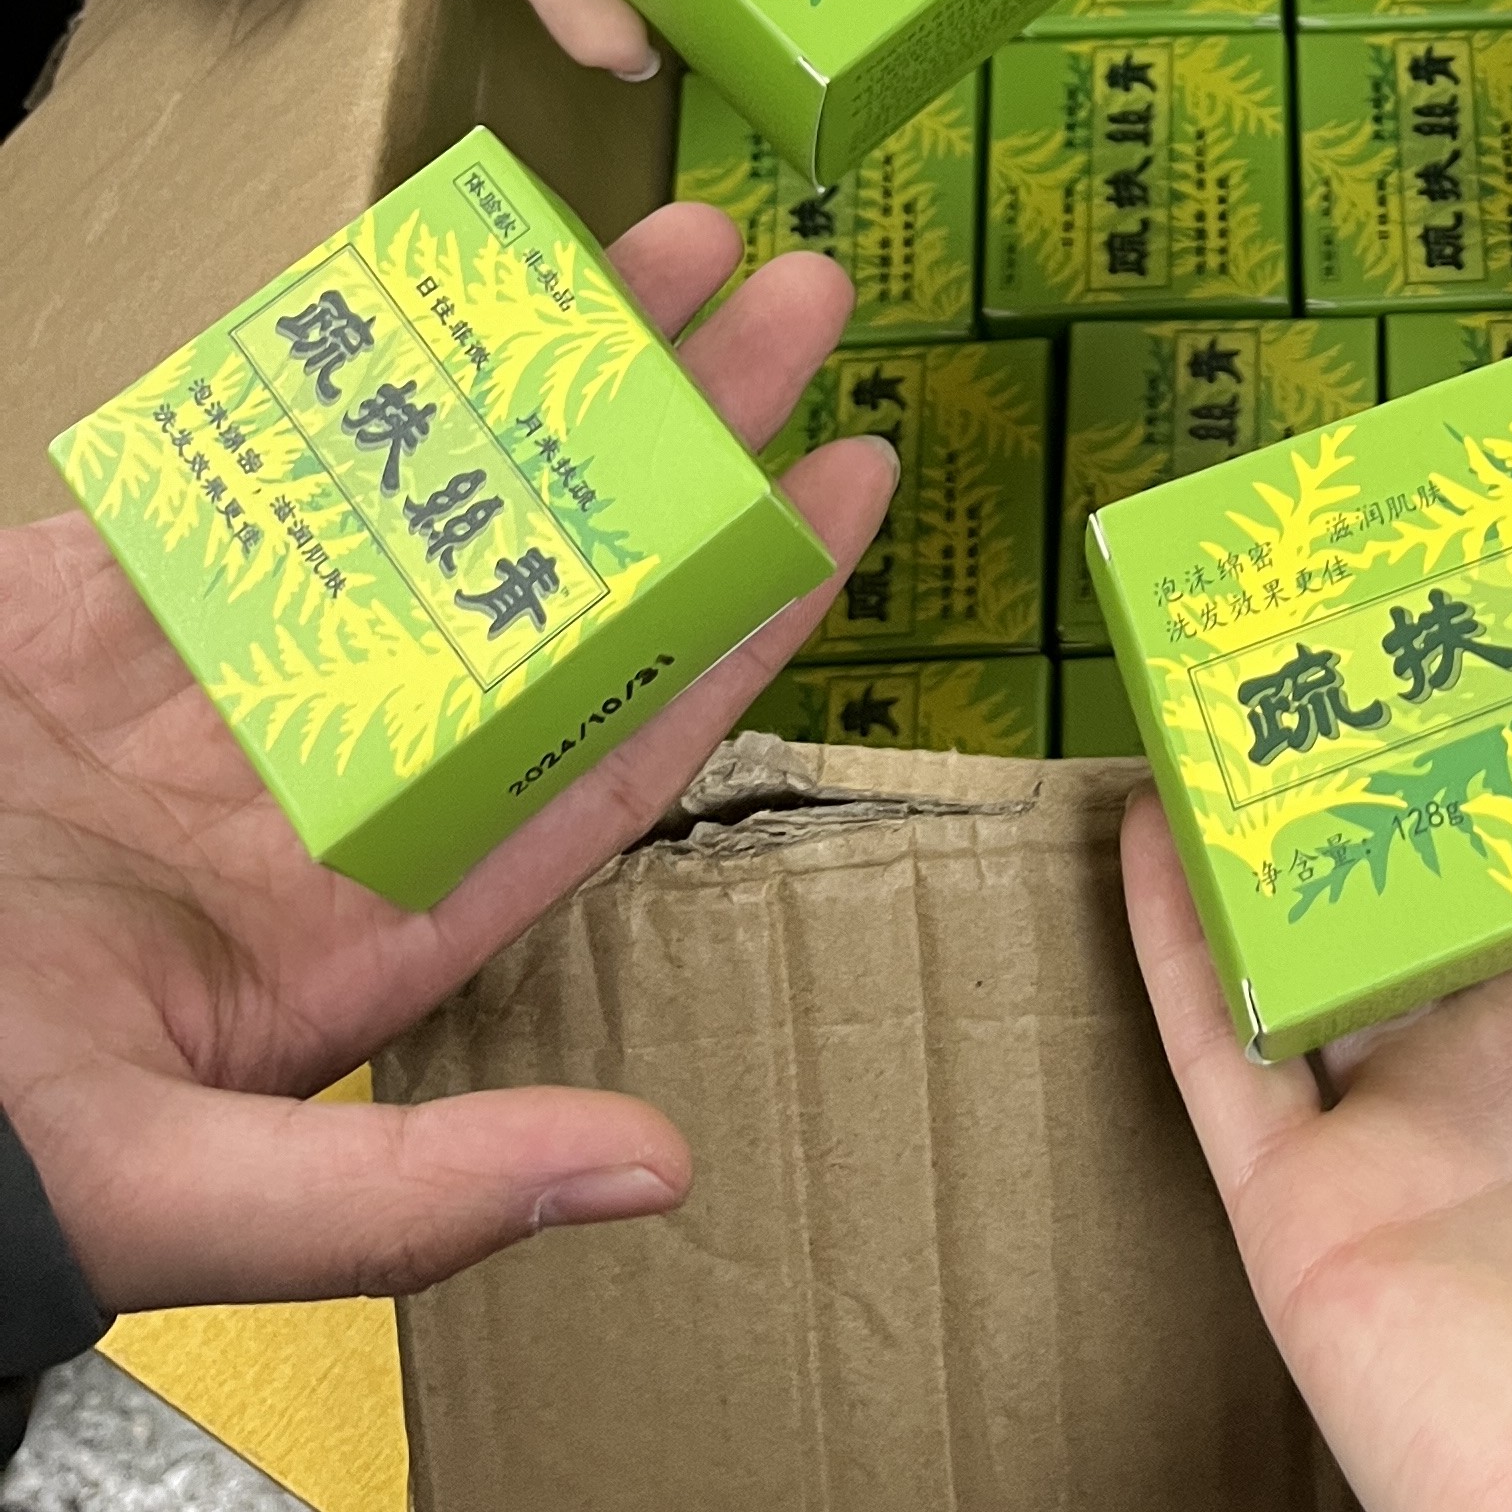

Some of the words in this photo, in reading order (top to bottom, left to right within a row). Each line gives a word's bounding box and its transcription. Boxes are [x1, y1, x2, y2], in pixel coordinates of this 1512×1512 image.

[521, 248, 577, 311] 非卖品
[152, 403, 262, 554] 洗发效果更佳
[1164, 554, 1352, 644] 洗发效果更佳
[510, 651, 675, 794] 2024/10/31
